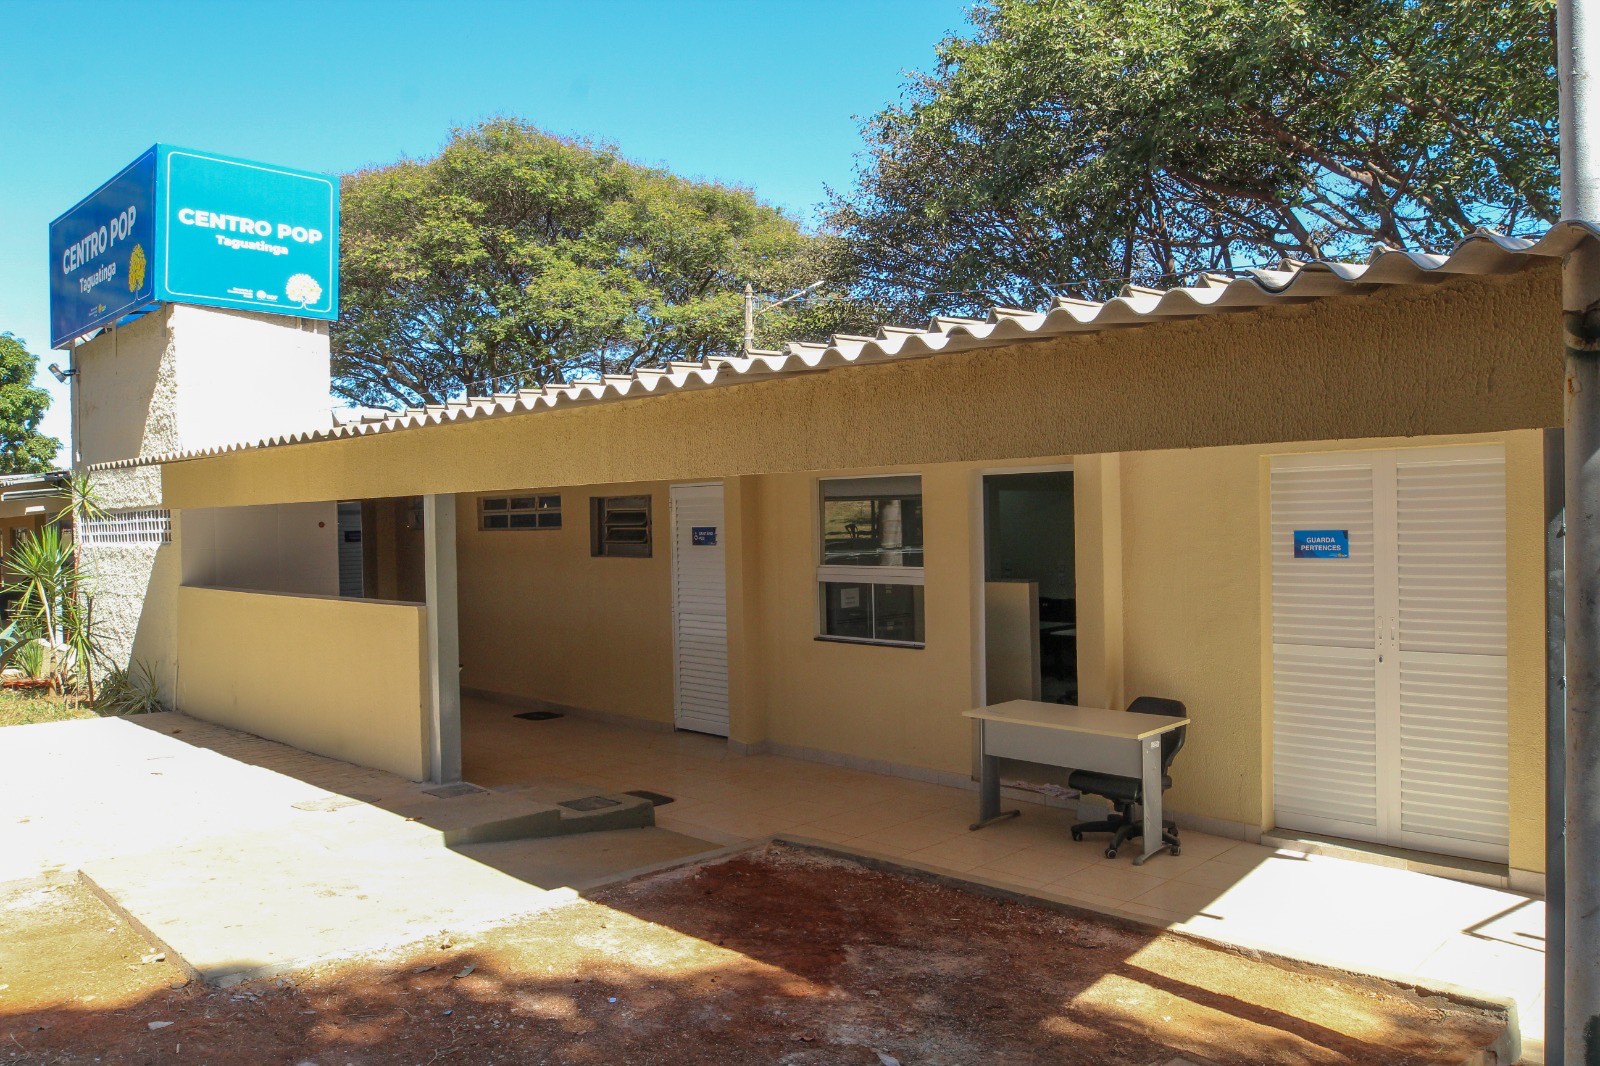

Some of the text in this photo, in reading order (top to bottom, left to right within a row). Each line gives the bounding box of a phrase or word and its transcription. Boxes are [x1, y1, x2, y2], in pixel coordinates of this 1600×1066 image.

[63, 205, 137, 275] CENTRO POP
[178, 207, 323, 245] CENTRO POP
[215, 234, 289, 256] Taguatinga
[79, 262, 116, 294] Taguatinga
